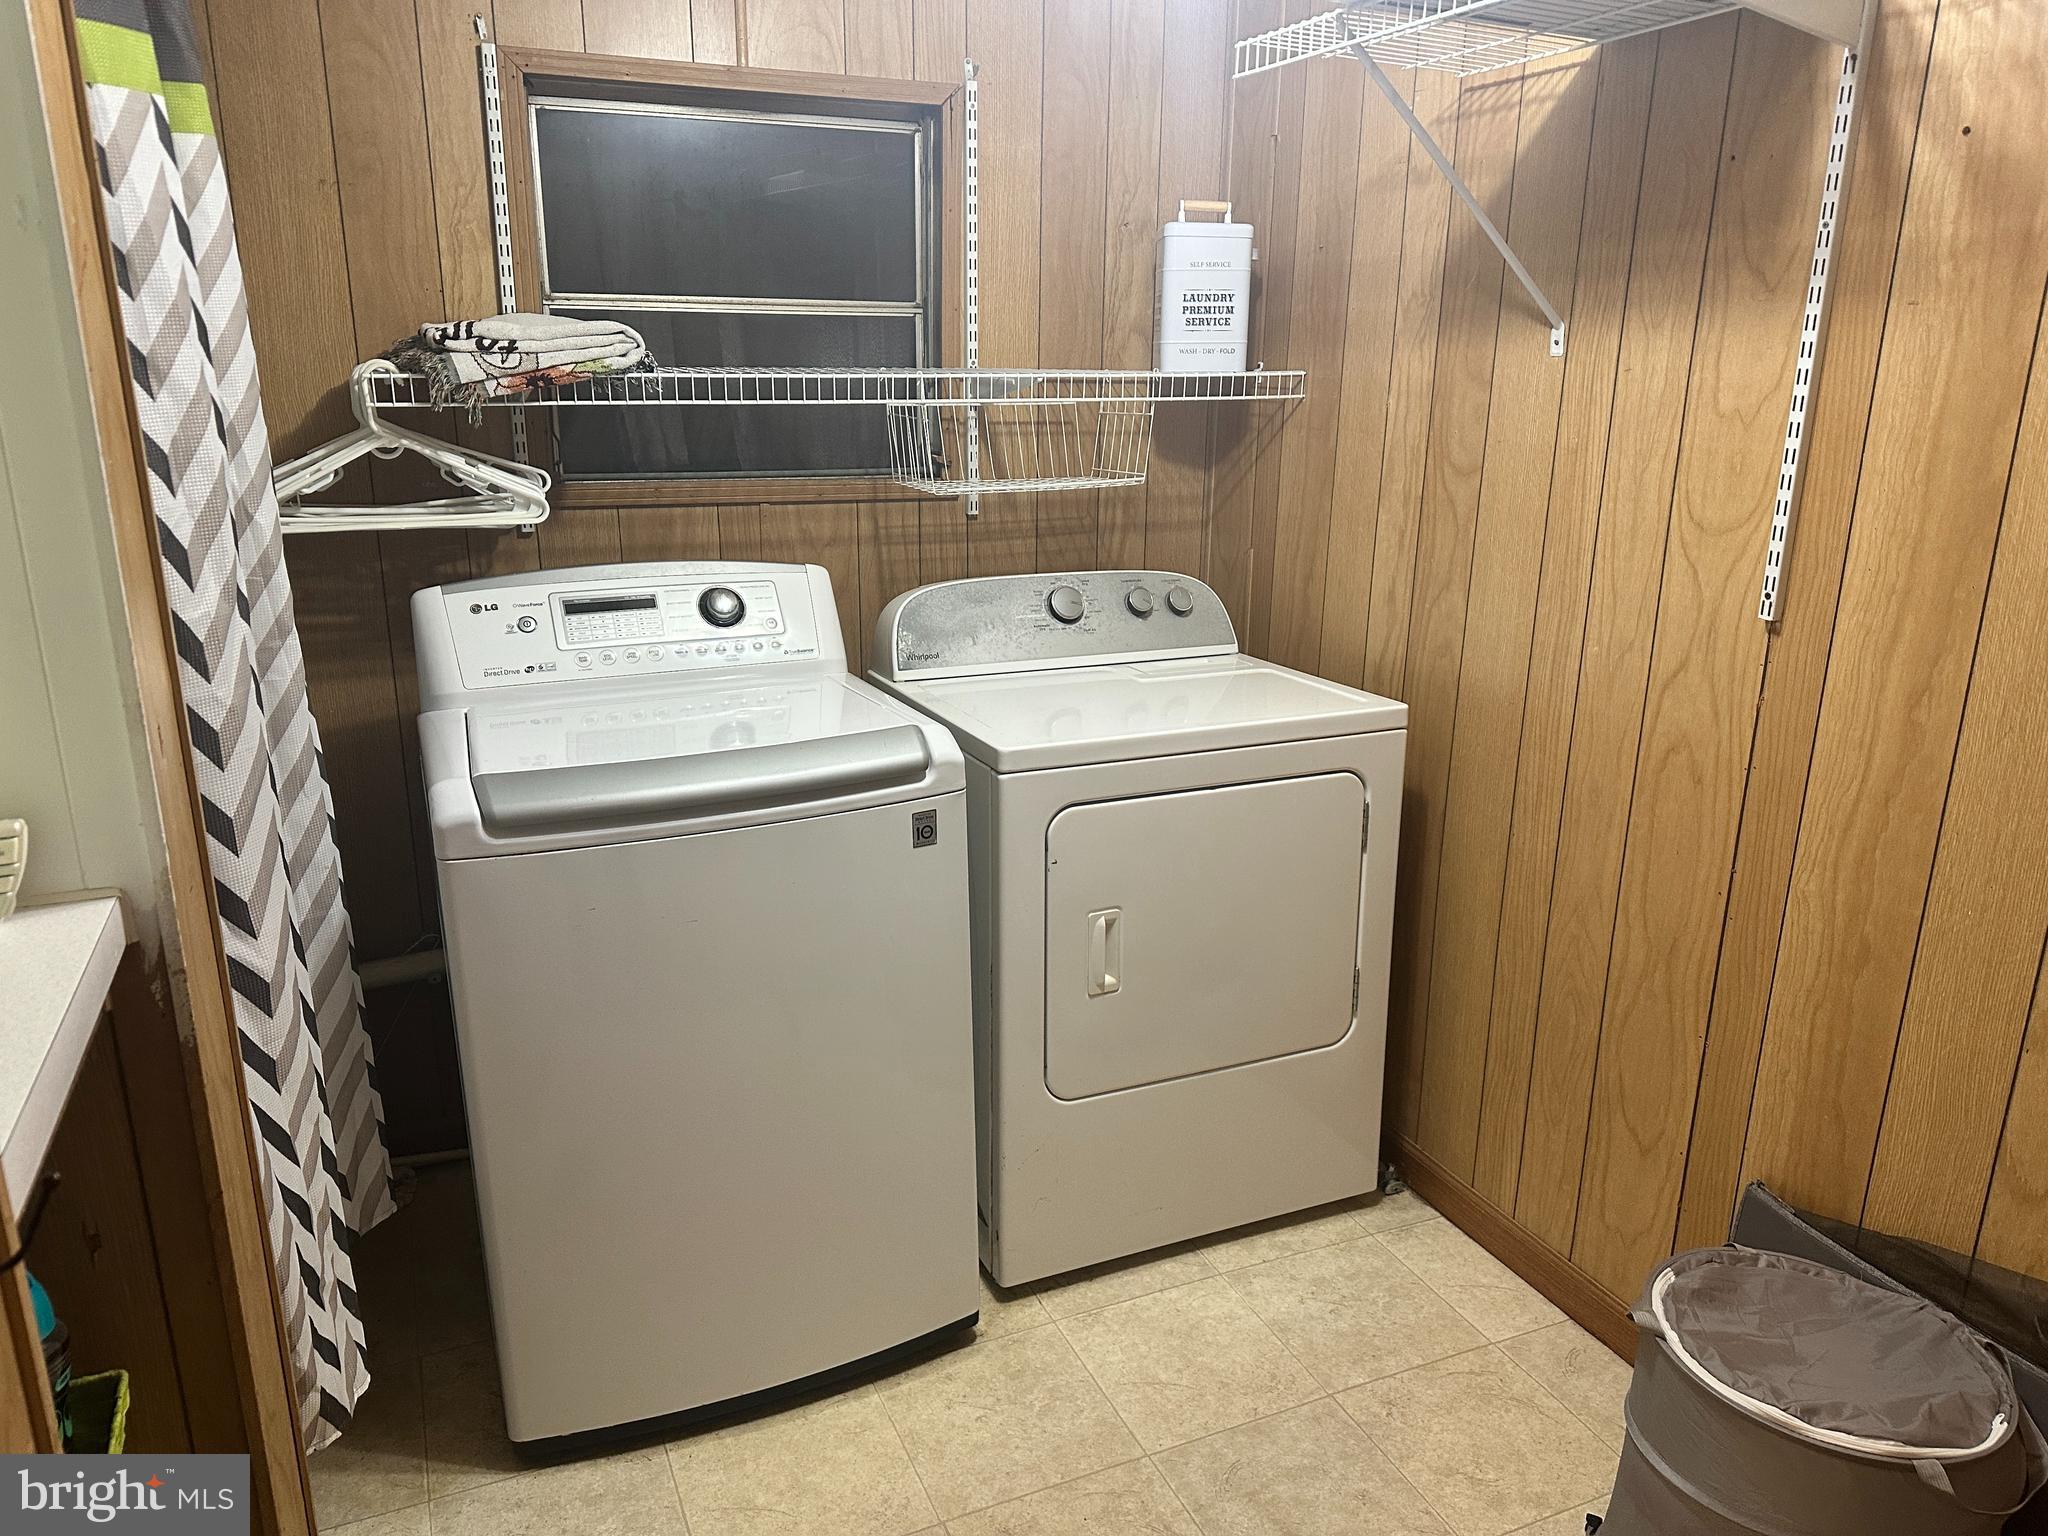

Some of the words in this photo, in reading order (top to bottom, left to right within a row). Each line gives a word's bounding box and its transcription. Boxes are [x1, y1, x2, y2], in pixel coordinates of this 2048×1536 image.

[1182, 293, 1235, 302] LAUNDRY
[1182, 305, 1235, 315] PREMIUM
[1185, 317, 1231, 326] SERVICE
[484, 603, 499, 612] LG
[906, 652, 940, 661] Whirlpool
[483, 670, 504, 678] Direct
[504, 668, 521, 676] Drive
